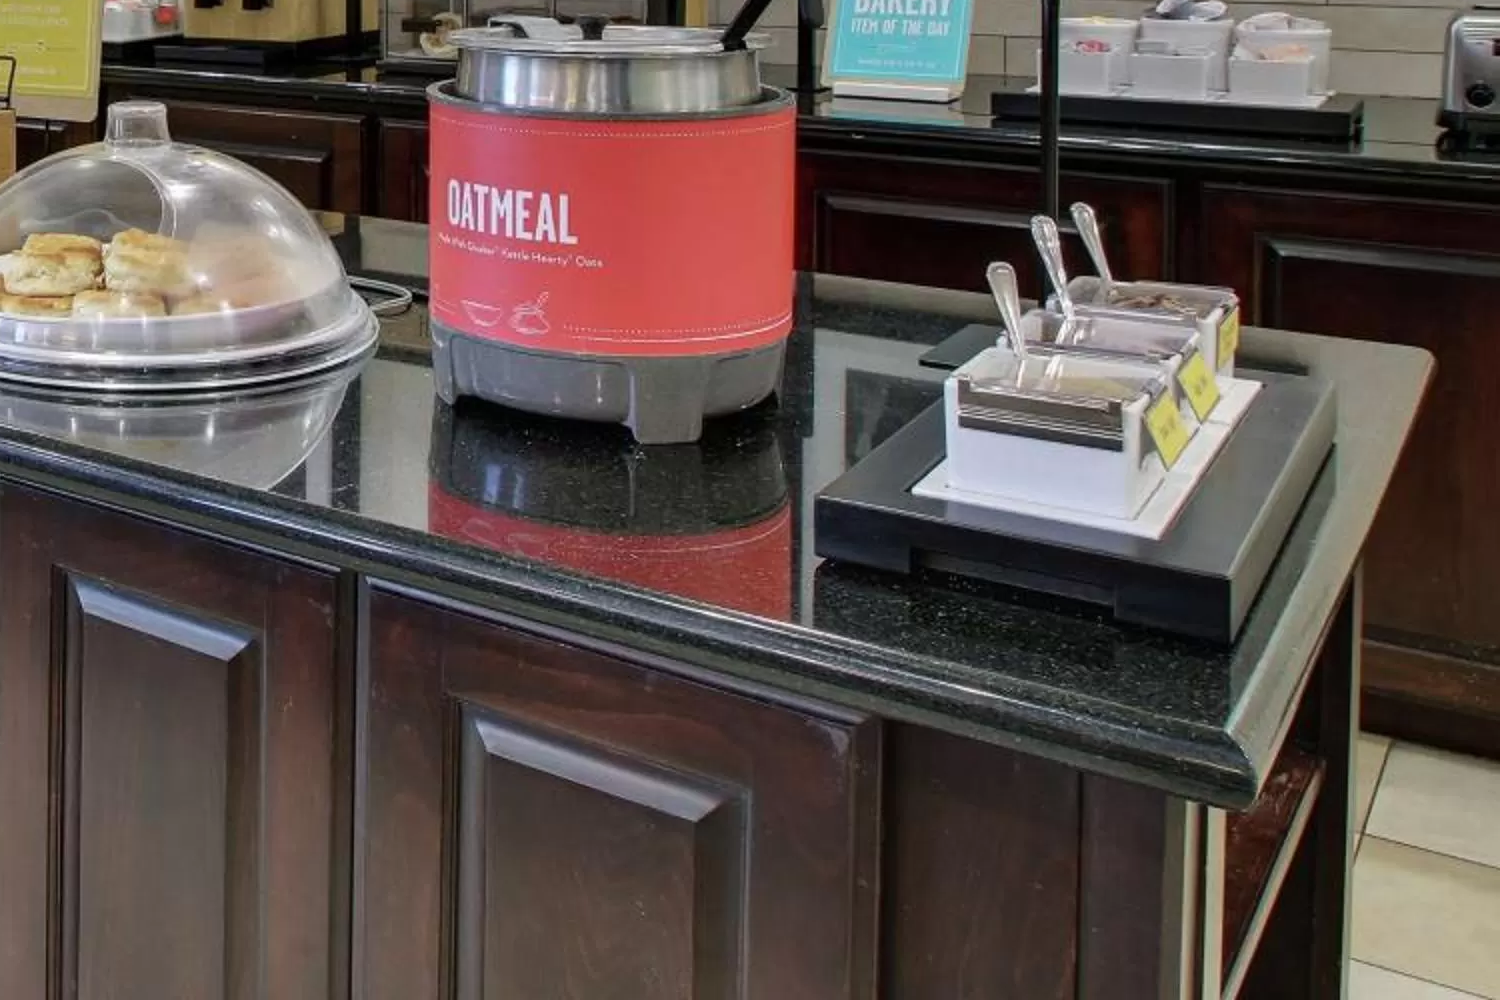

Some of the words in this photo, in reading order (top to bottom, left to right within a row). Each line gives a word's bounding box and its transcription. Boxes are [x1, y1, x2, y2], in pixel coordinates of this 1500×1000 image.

[851, 18, 878, 34] ITEM
[882, 19, 898, 35] OF
[902, 19, 924, 36] THE
[928, 20, 951, 36] DAY
[448, 179, 578, 245] OATMEAL
